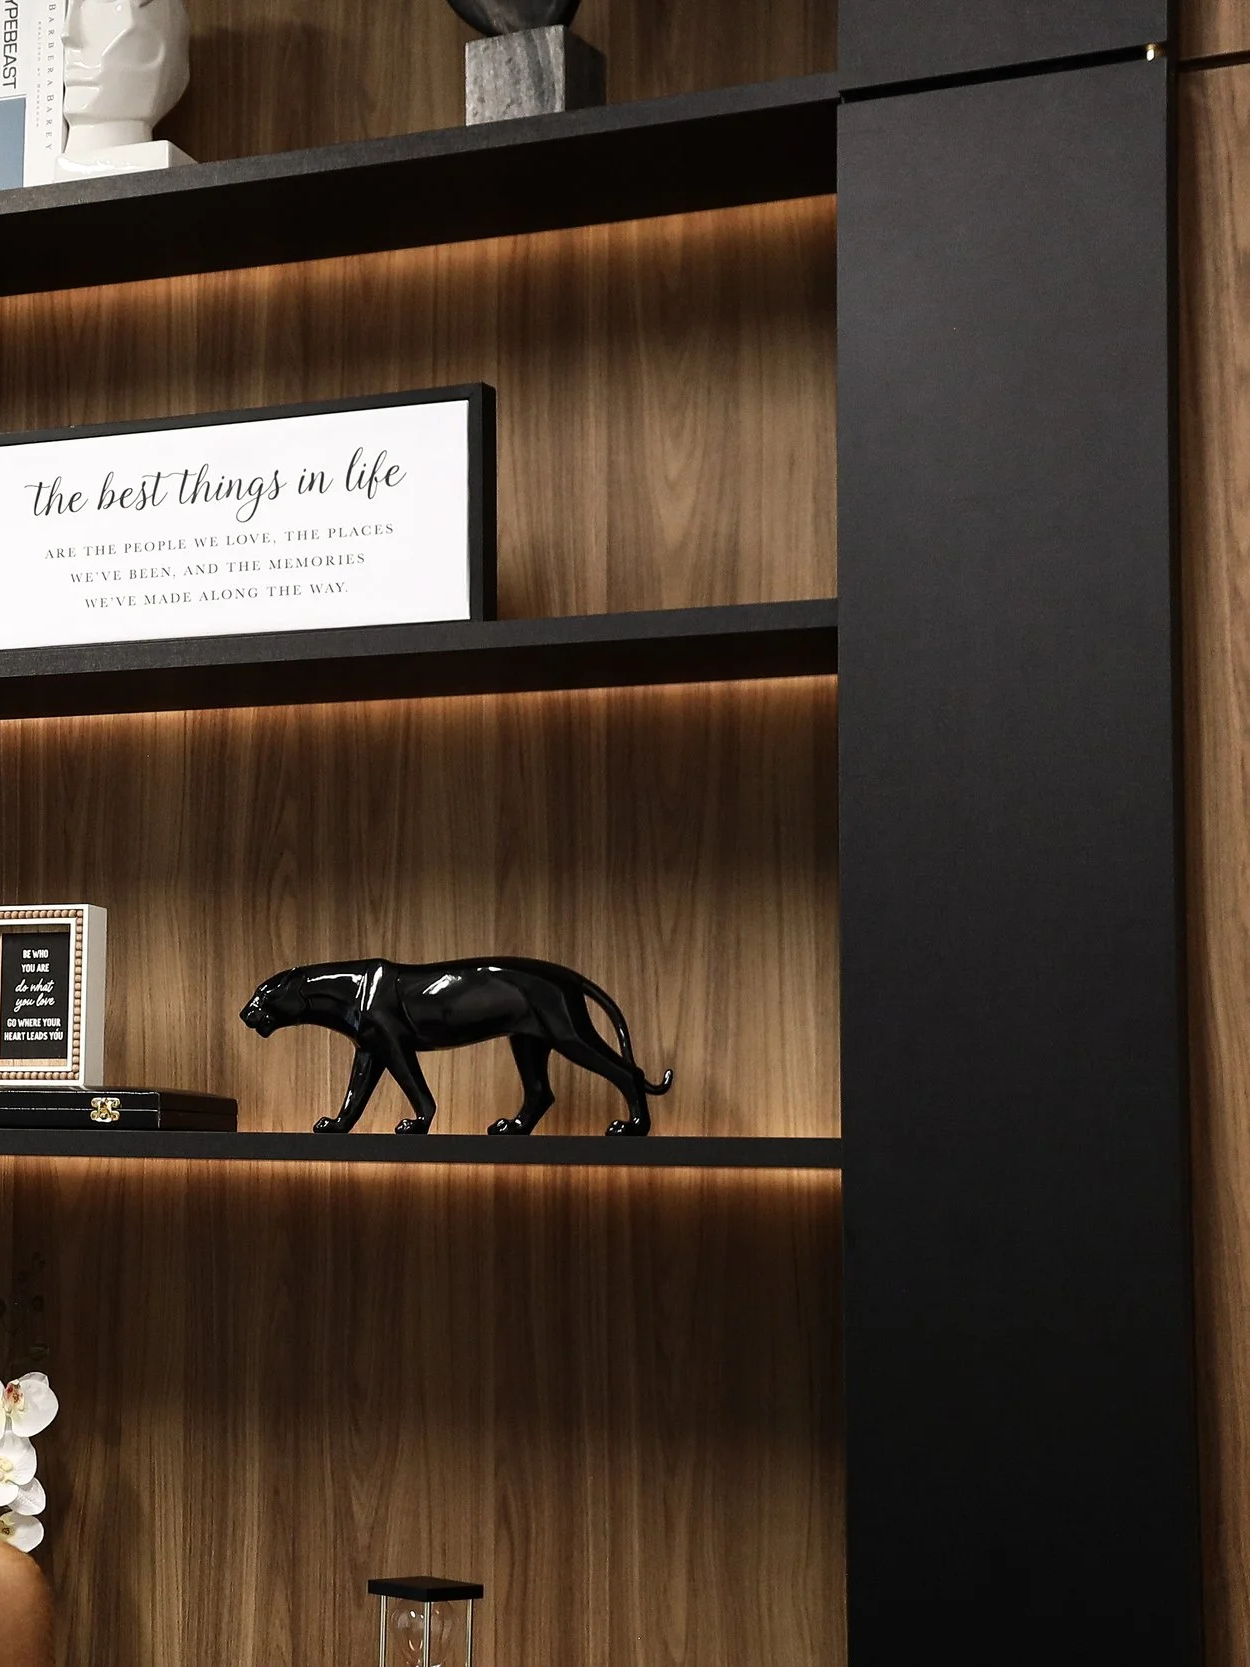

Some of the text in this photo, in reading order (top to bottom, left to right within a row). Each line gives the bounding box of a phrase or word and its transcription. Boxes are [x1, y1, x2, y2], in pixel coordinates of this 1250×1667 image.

[24, 447, 407, 523] the best things in life
[45, 524, 394, 560] ARE THE PEOPLE WE LOVE, THE PLACES
[70, 554, 365, 583] WE'VE BEEN, AND THE MEMORIES
[85, 582, 348, 609] WE'VE MADE ALONG THE WAY.
[22, 949, 48, 959] BE WHO
[21, 963, 49, 973] YOU ARE
[14, 978, 55, 993] do what
[13, 993, 56, 1013] you love
[6, 1018, 61, 1028] GO WHERE YOUR
[4, 1031, 26, 1041] HEART
[27, 1032, 48, 1041] LEADS
